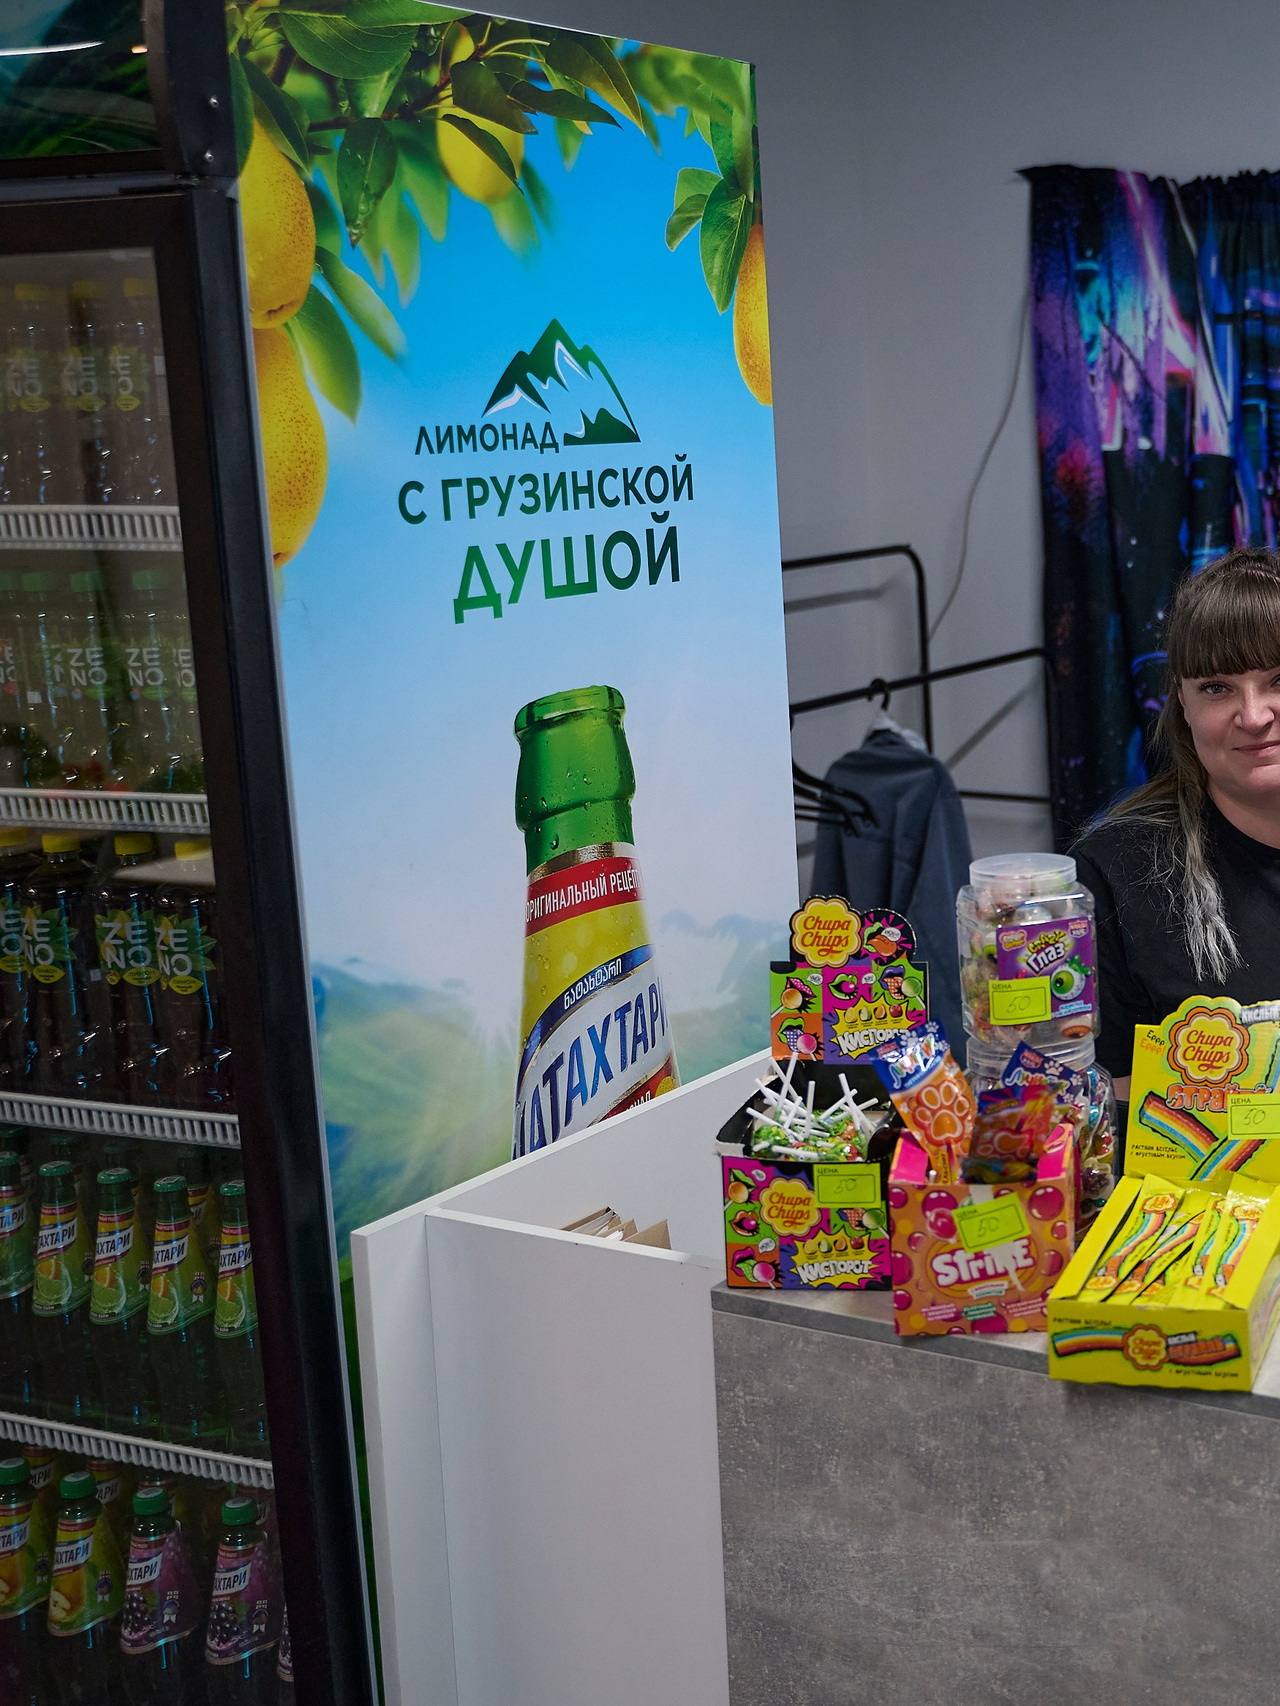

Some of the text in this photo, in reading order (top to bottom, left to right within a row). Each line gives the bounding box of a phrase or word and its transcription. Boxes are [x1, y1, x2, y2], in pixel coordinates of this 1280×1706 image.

[414, 421, 560, 455] ЛИМОНАД
[398, 453, 695, 525] С ГРУЗИНСКОЙ
[453, 510, 681, 624] ДУШОЙ
[524, 872, 608, 923] ОРИГИНАЛЬНЫЙ
[803, 915, 851, 932] Chupa
[801, 931, 849, 956] Chups
[1027, 942, 1065, 972] Глаз
[1007, 996, 1030, 1013] 50
[1186, 1030, 1234, 1049] Chupa
[1182, 1046, 1231, 1071] Chups
[1243, 1108, 1266, 1126] 50
[817, 1167, 838, 1175] ЦЕНА
[834, 1178, 857, 1194] 50
[769, 1192, 812, 1206] Chupa
[767, 1205, 810, 1227] Chups
[978, 1217, 999, 1237] 50
